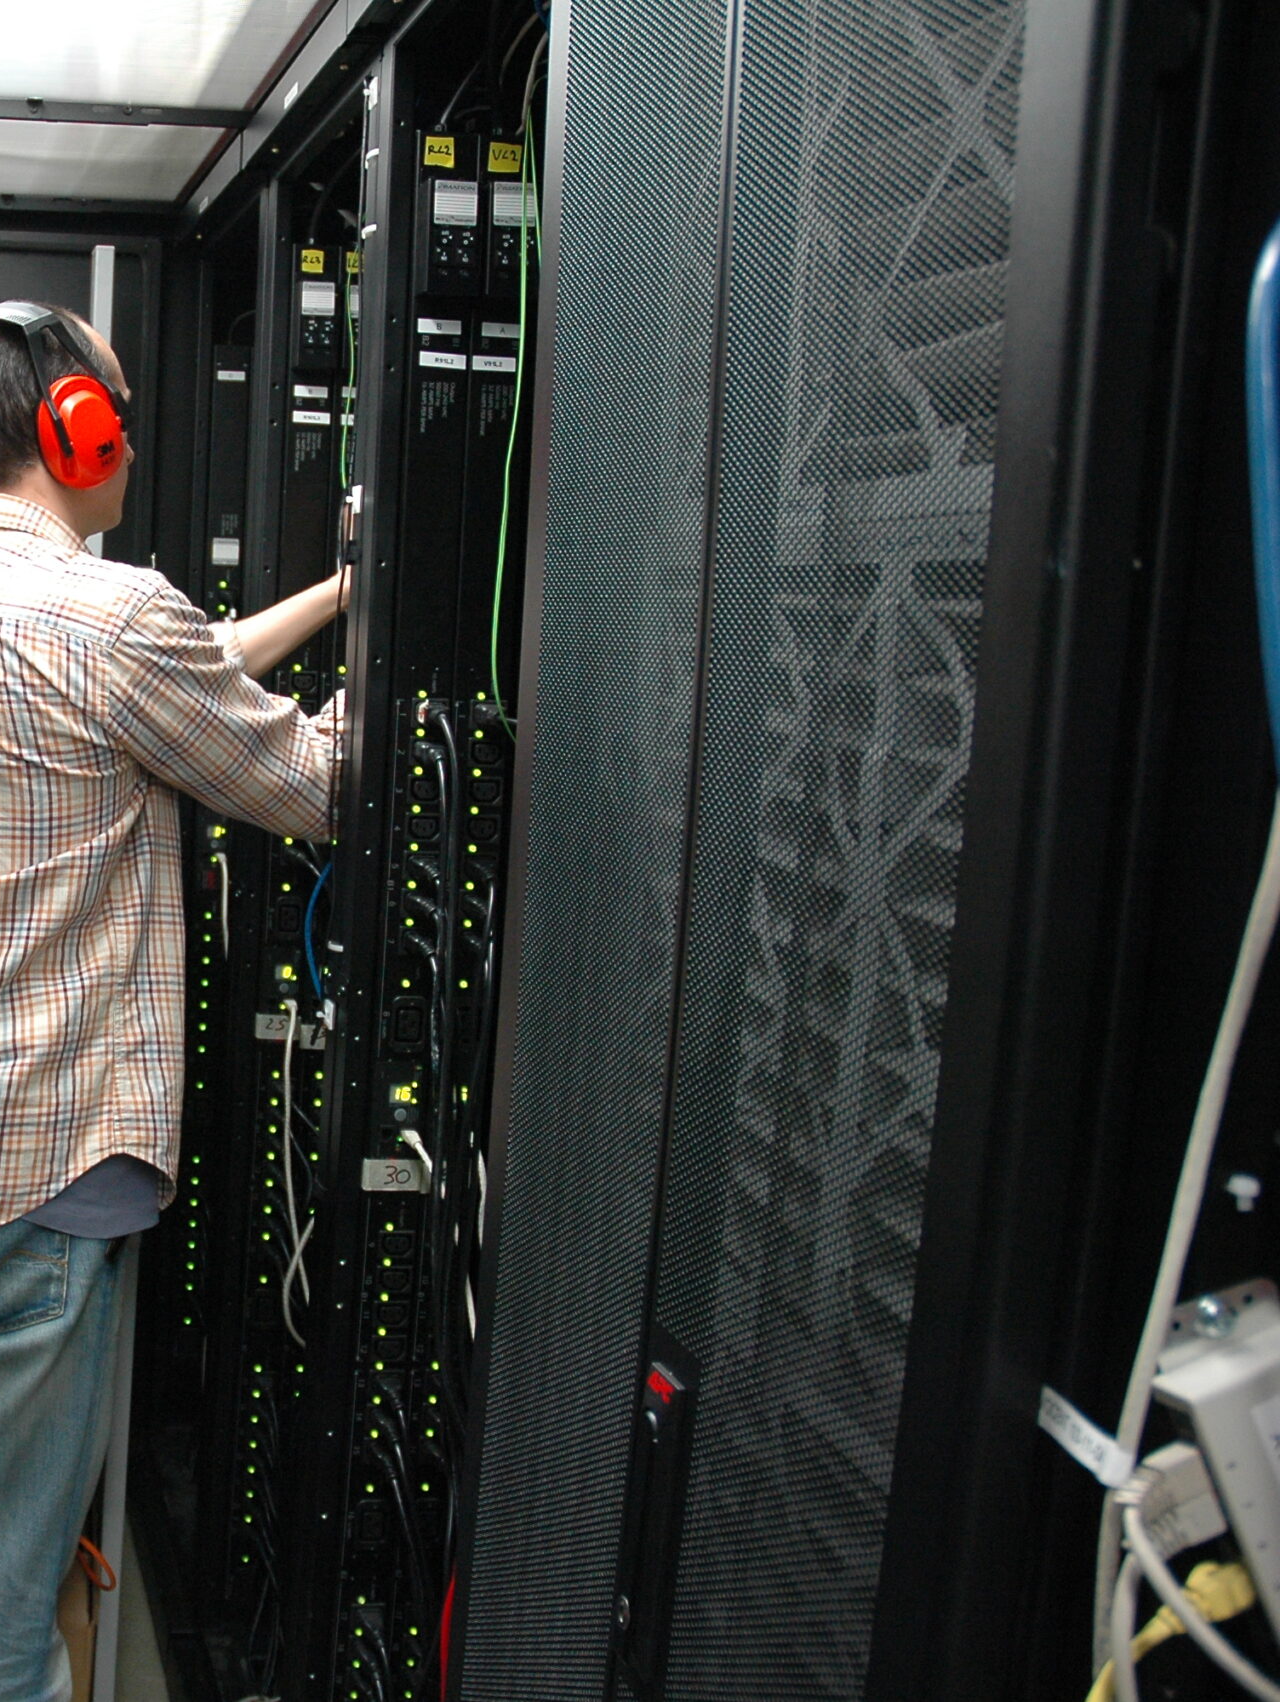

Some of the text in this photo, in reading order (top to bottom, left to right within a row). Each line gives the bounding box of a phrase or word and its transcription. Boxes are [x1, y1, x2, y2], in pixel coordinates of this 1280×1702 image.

[428, 144, 452, 156] RL2
[492, 149, 519, 162] VL2
[265, 1017, 288, 1031] 25
[384, 1165, 411, 1185] 30
